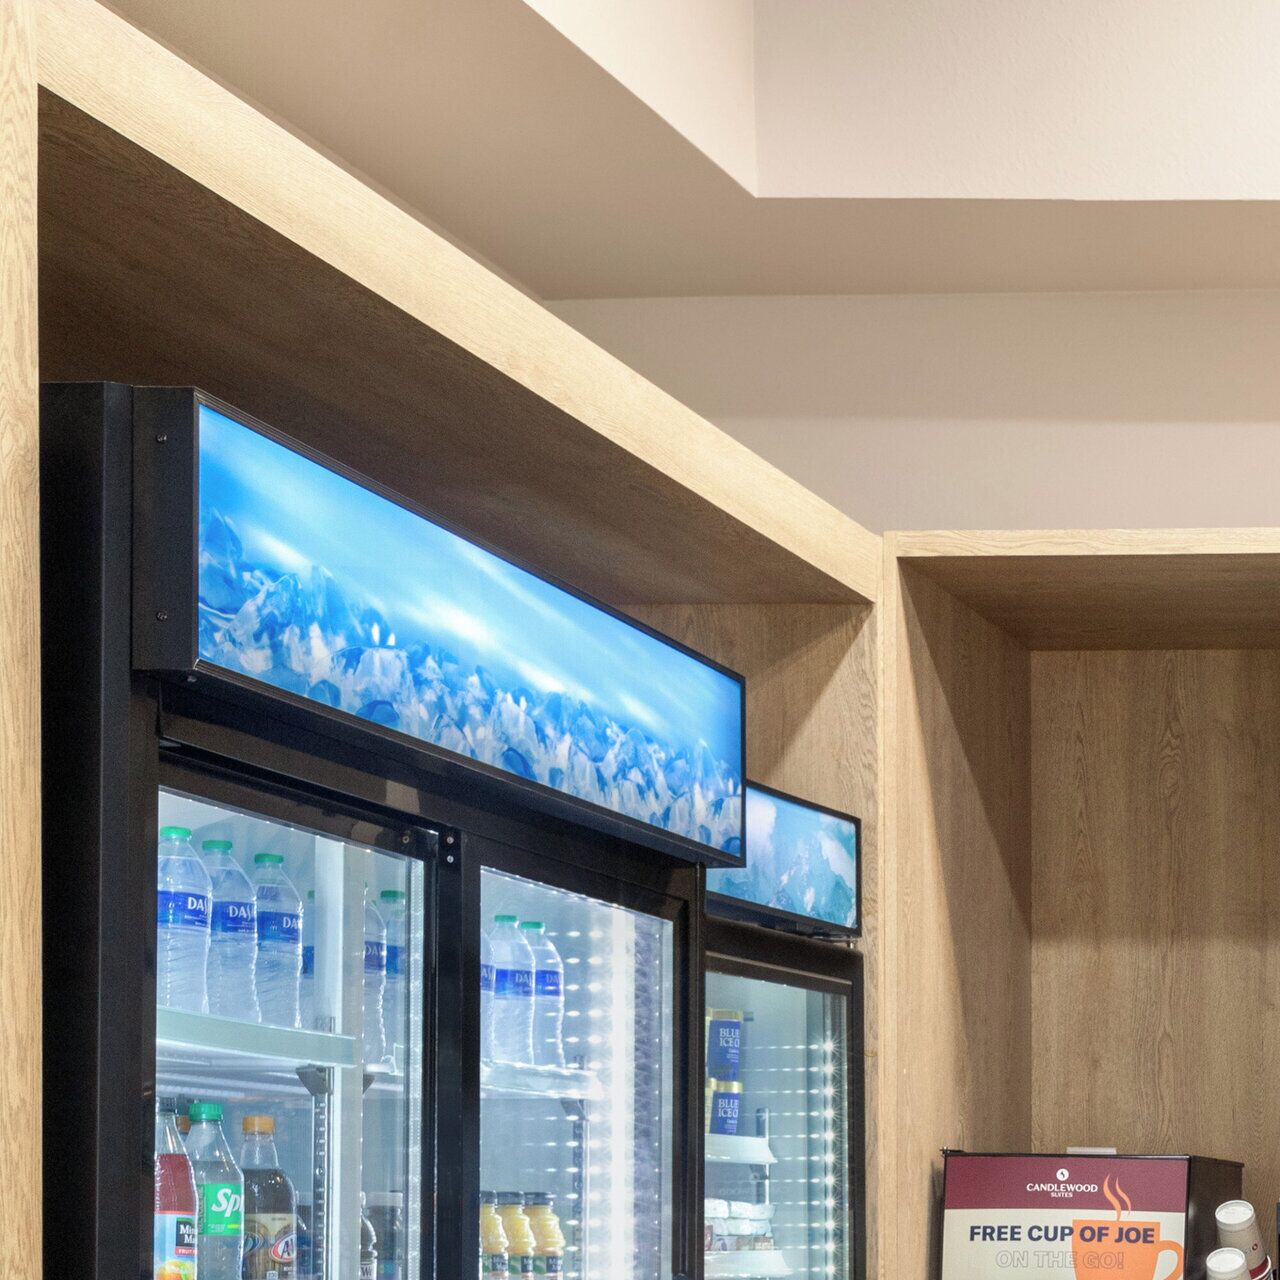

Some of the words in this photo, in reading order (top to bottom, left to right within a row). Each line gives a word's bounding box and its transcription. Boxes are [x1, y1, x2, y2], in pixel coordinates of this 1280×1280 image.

[1027, 1183, 1098, 1193] CANDLEWOOD
[969, 1226, 1021, 1241] FREE
[1027, 1226, 1073, 1242] CUP
[1079, 1226, 1109, 1243] OF
[1114, 1226, 1155, 1244] JOE
[995, 1250, 1029, 1268] ON
[1034, 1250, 1077, 1269] THE
[1083, 1251, 1124, 1269] GO!
